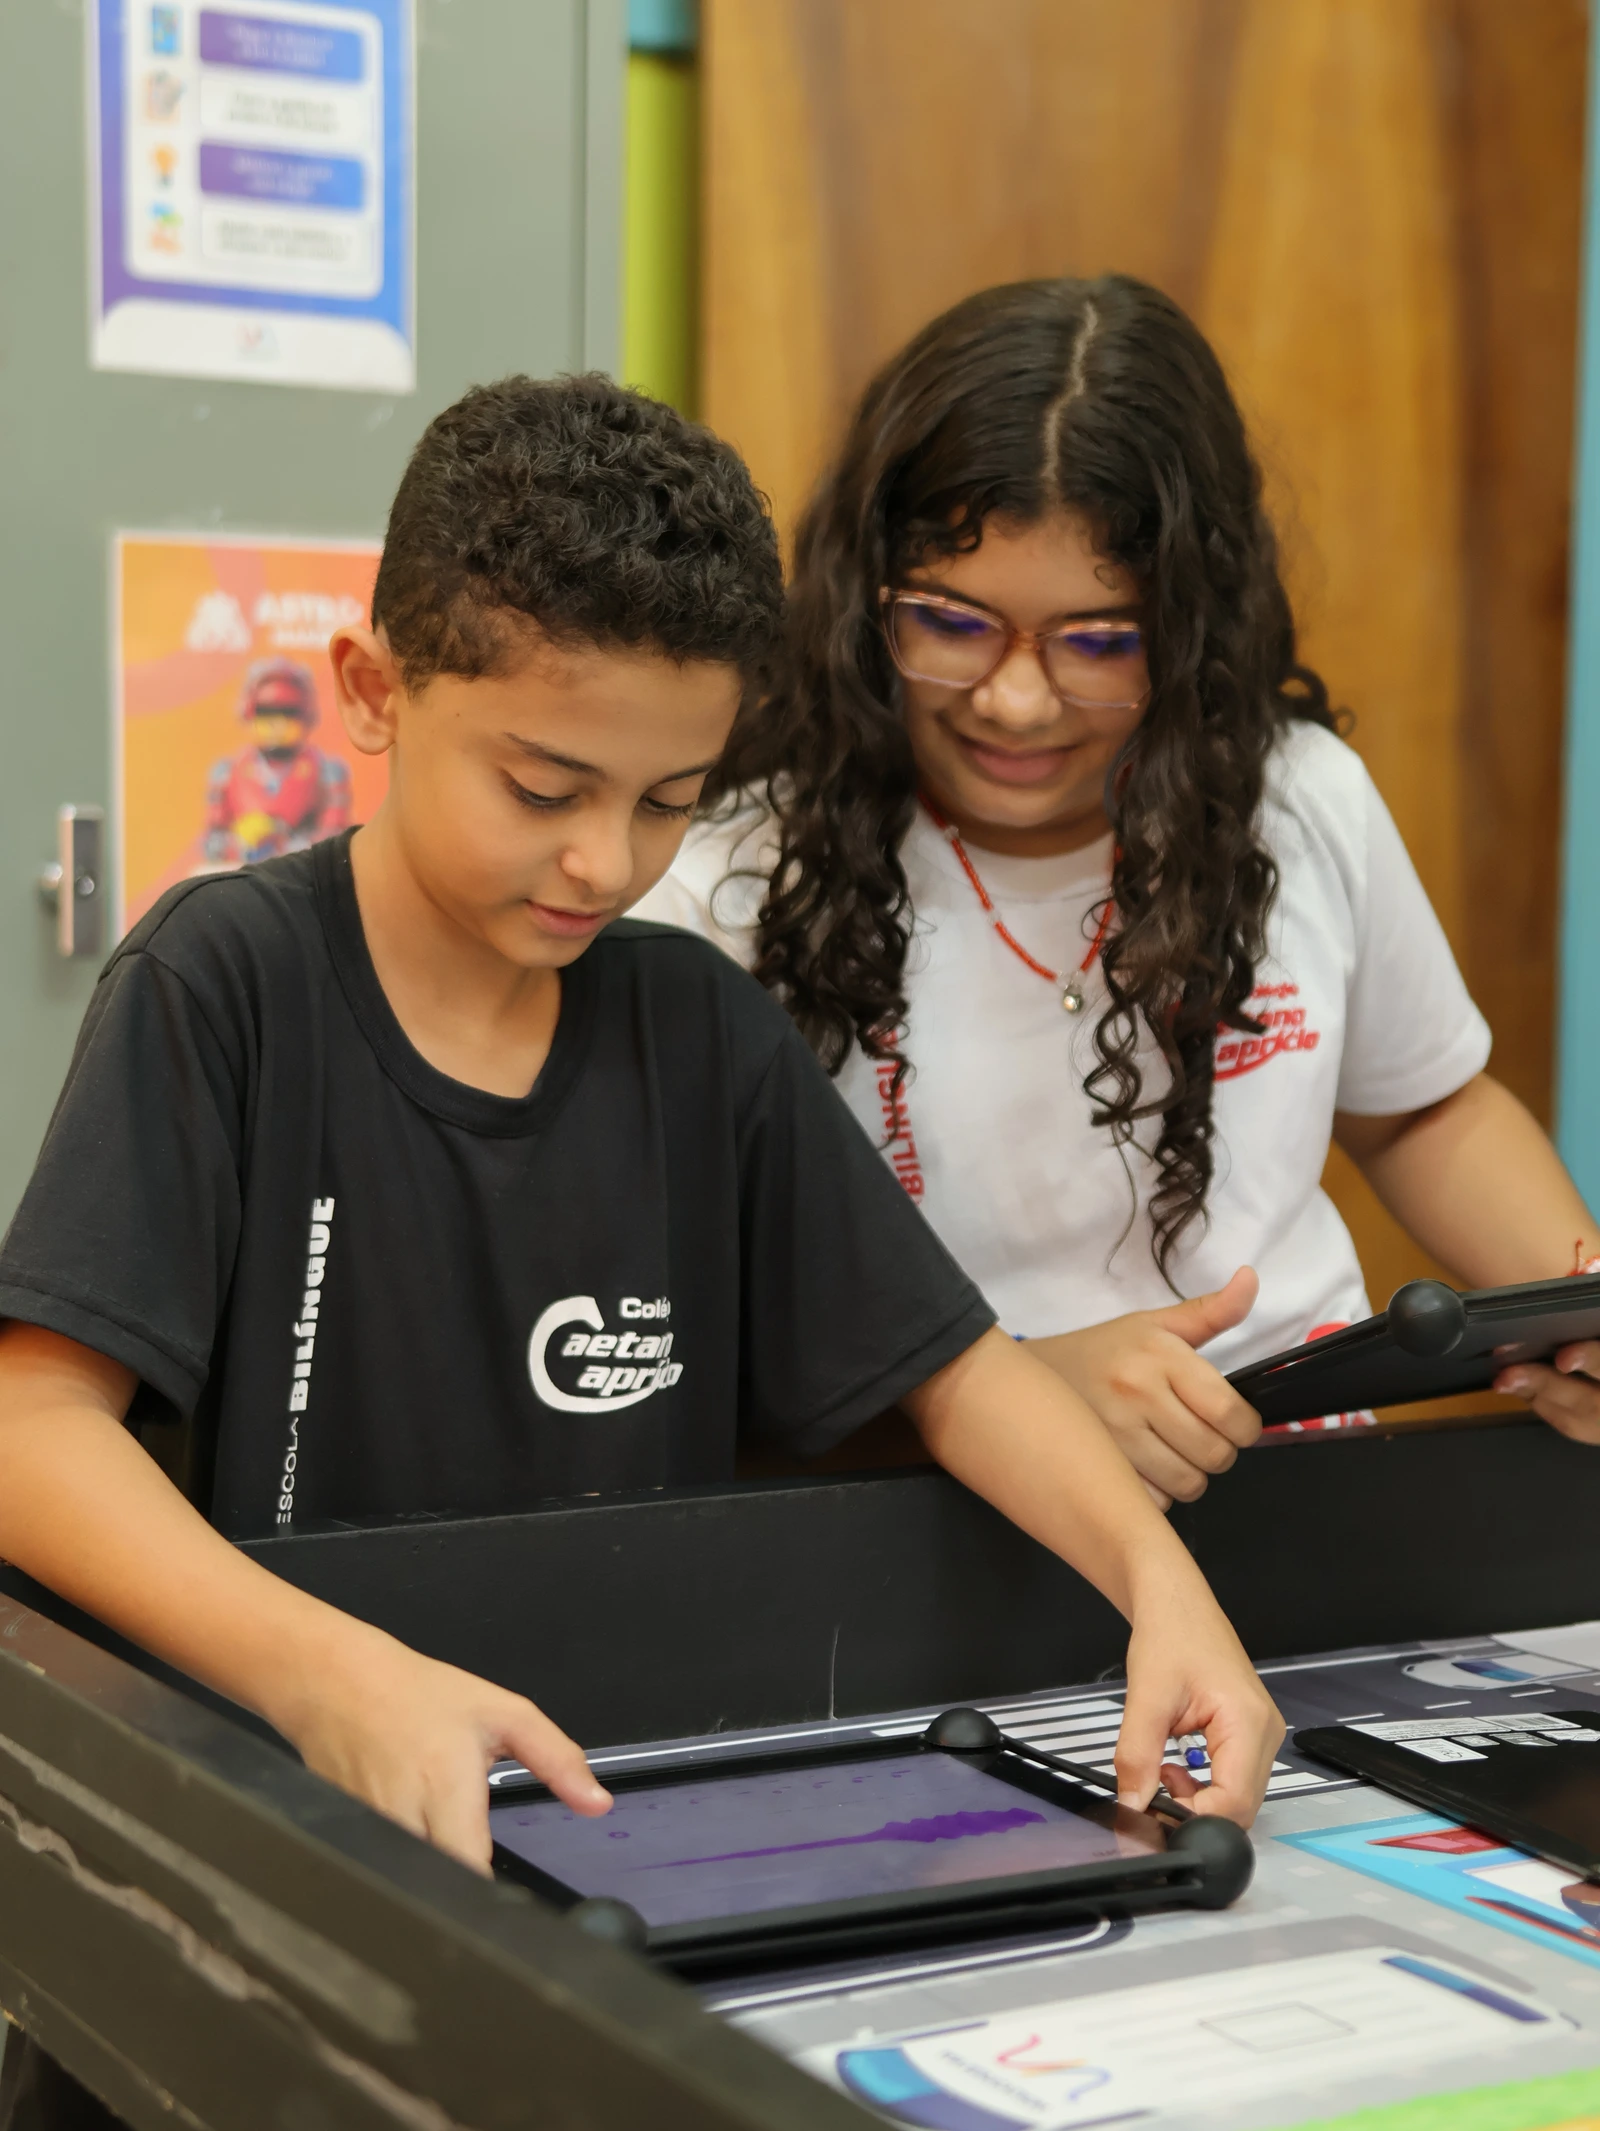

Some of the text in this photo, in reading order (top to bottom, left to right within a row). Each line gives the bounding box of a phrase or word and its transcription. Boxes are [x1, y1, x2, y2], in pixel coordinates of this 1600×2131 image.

[276, 1197, 335, 1524] ESCOLA BILÍNGUE
[619, 1296, 671, 1322] Colé
